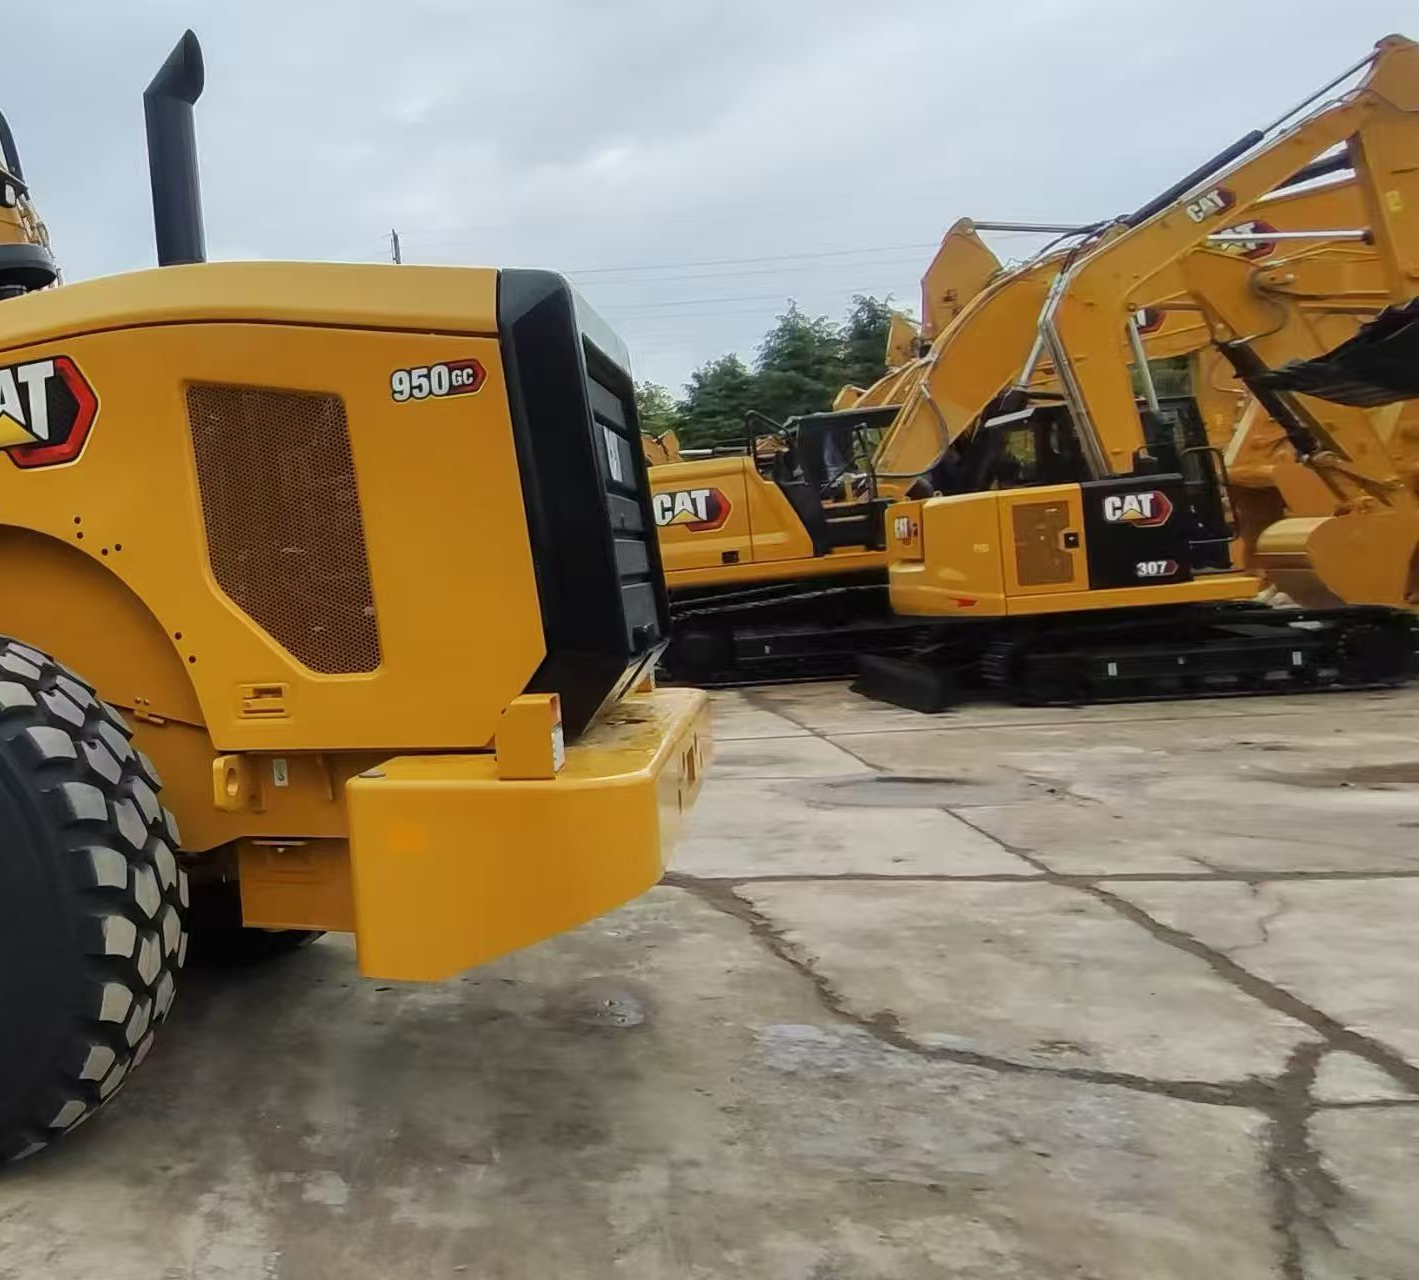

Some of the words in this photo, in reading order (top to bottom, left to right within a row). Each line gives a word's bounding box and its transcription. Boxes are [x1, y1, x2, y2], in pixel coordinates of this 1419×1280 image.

[1187, 190, 1226, 222] CAT
[653, 489, 710, 526] CAT
[1104, 493, 1155, 521] CAT
[1136, 561, 1168, 577] 307
